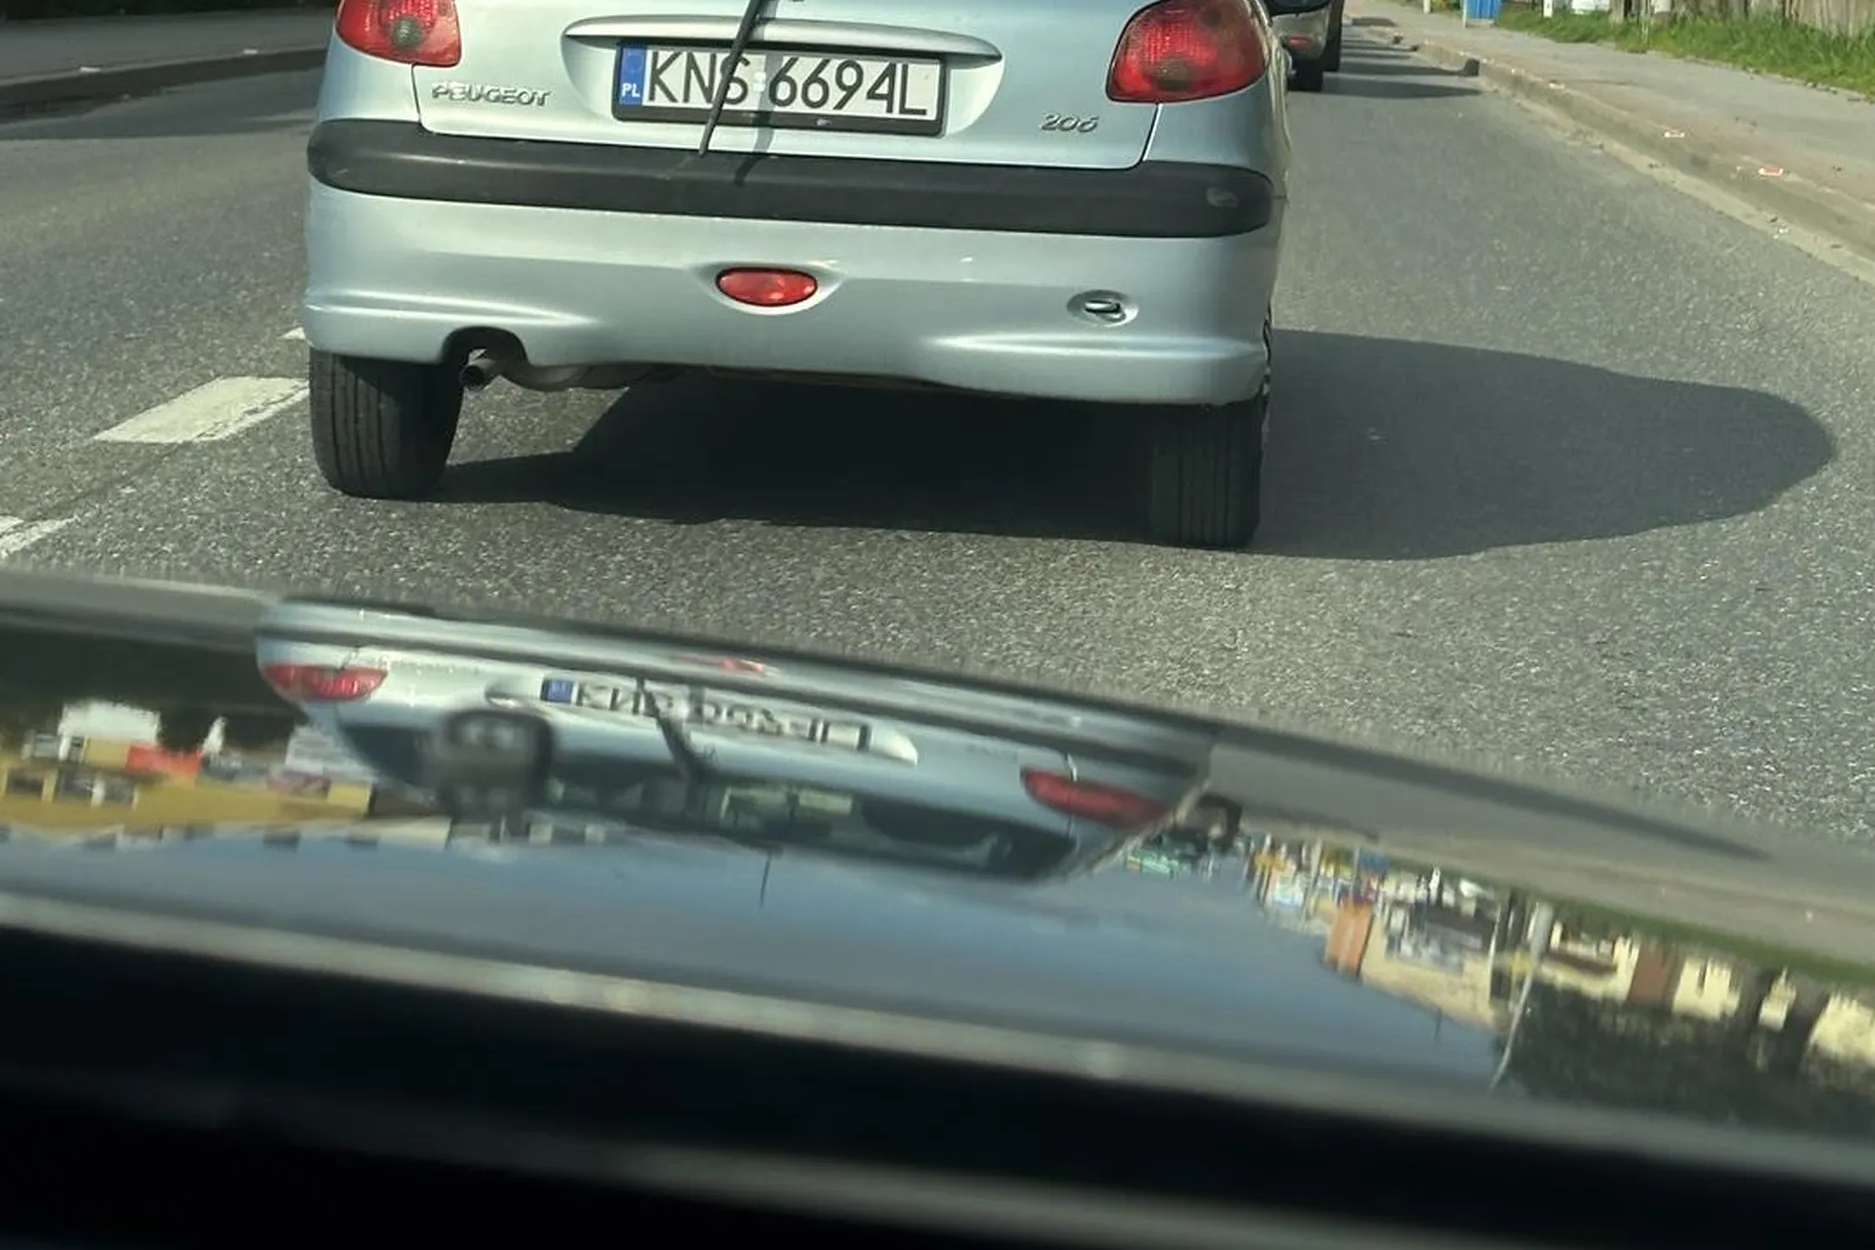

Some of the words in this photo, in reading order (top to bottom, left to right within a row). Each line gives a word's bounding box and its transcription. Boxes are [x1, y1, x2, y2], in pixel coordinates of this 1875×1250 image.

[431, 82, 551, 106] PEUGEOT
[621, 83, 641, 98] PL
[649, 51, 750, 105] KNS
[768, 56, 927, 115] 6694L
[1041, 113, 1099, 133] 206
